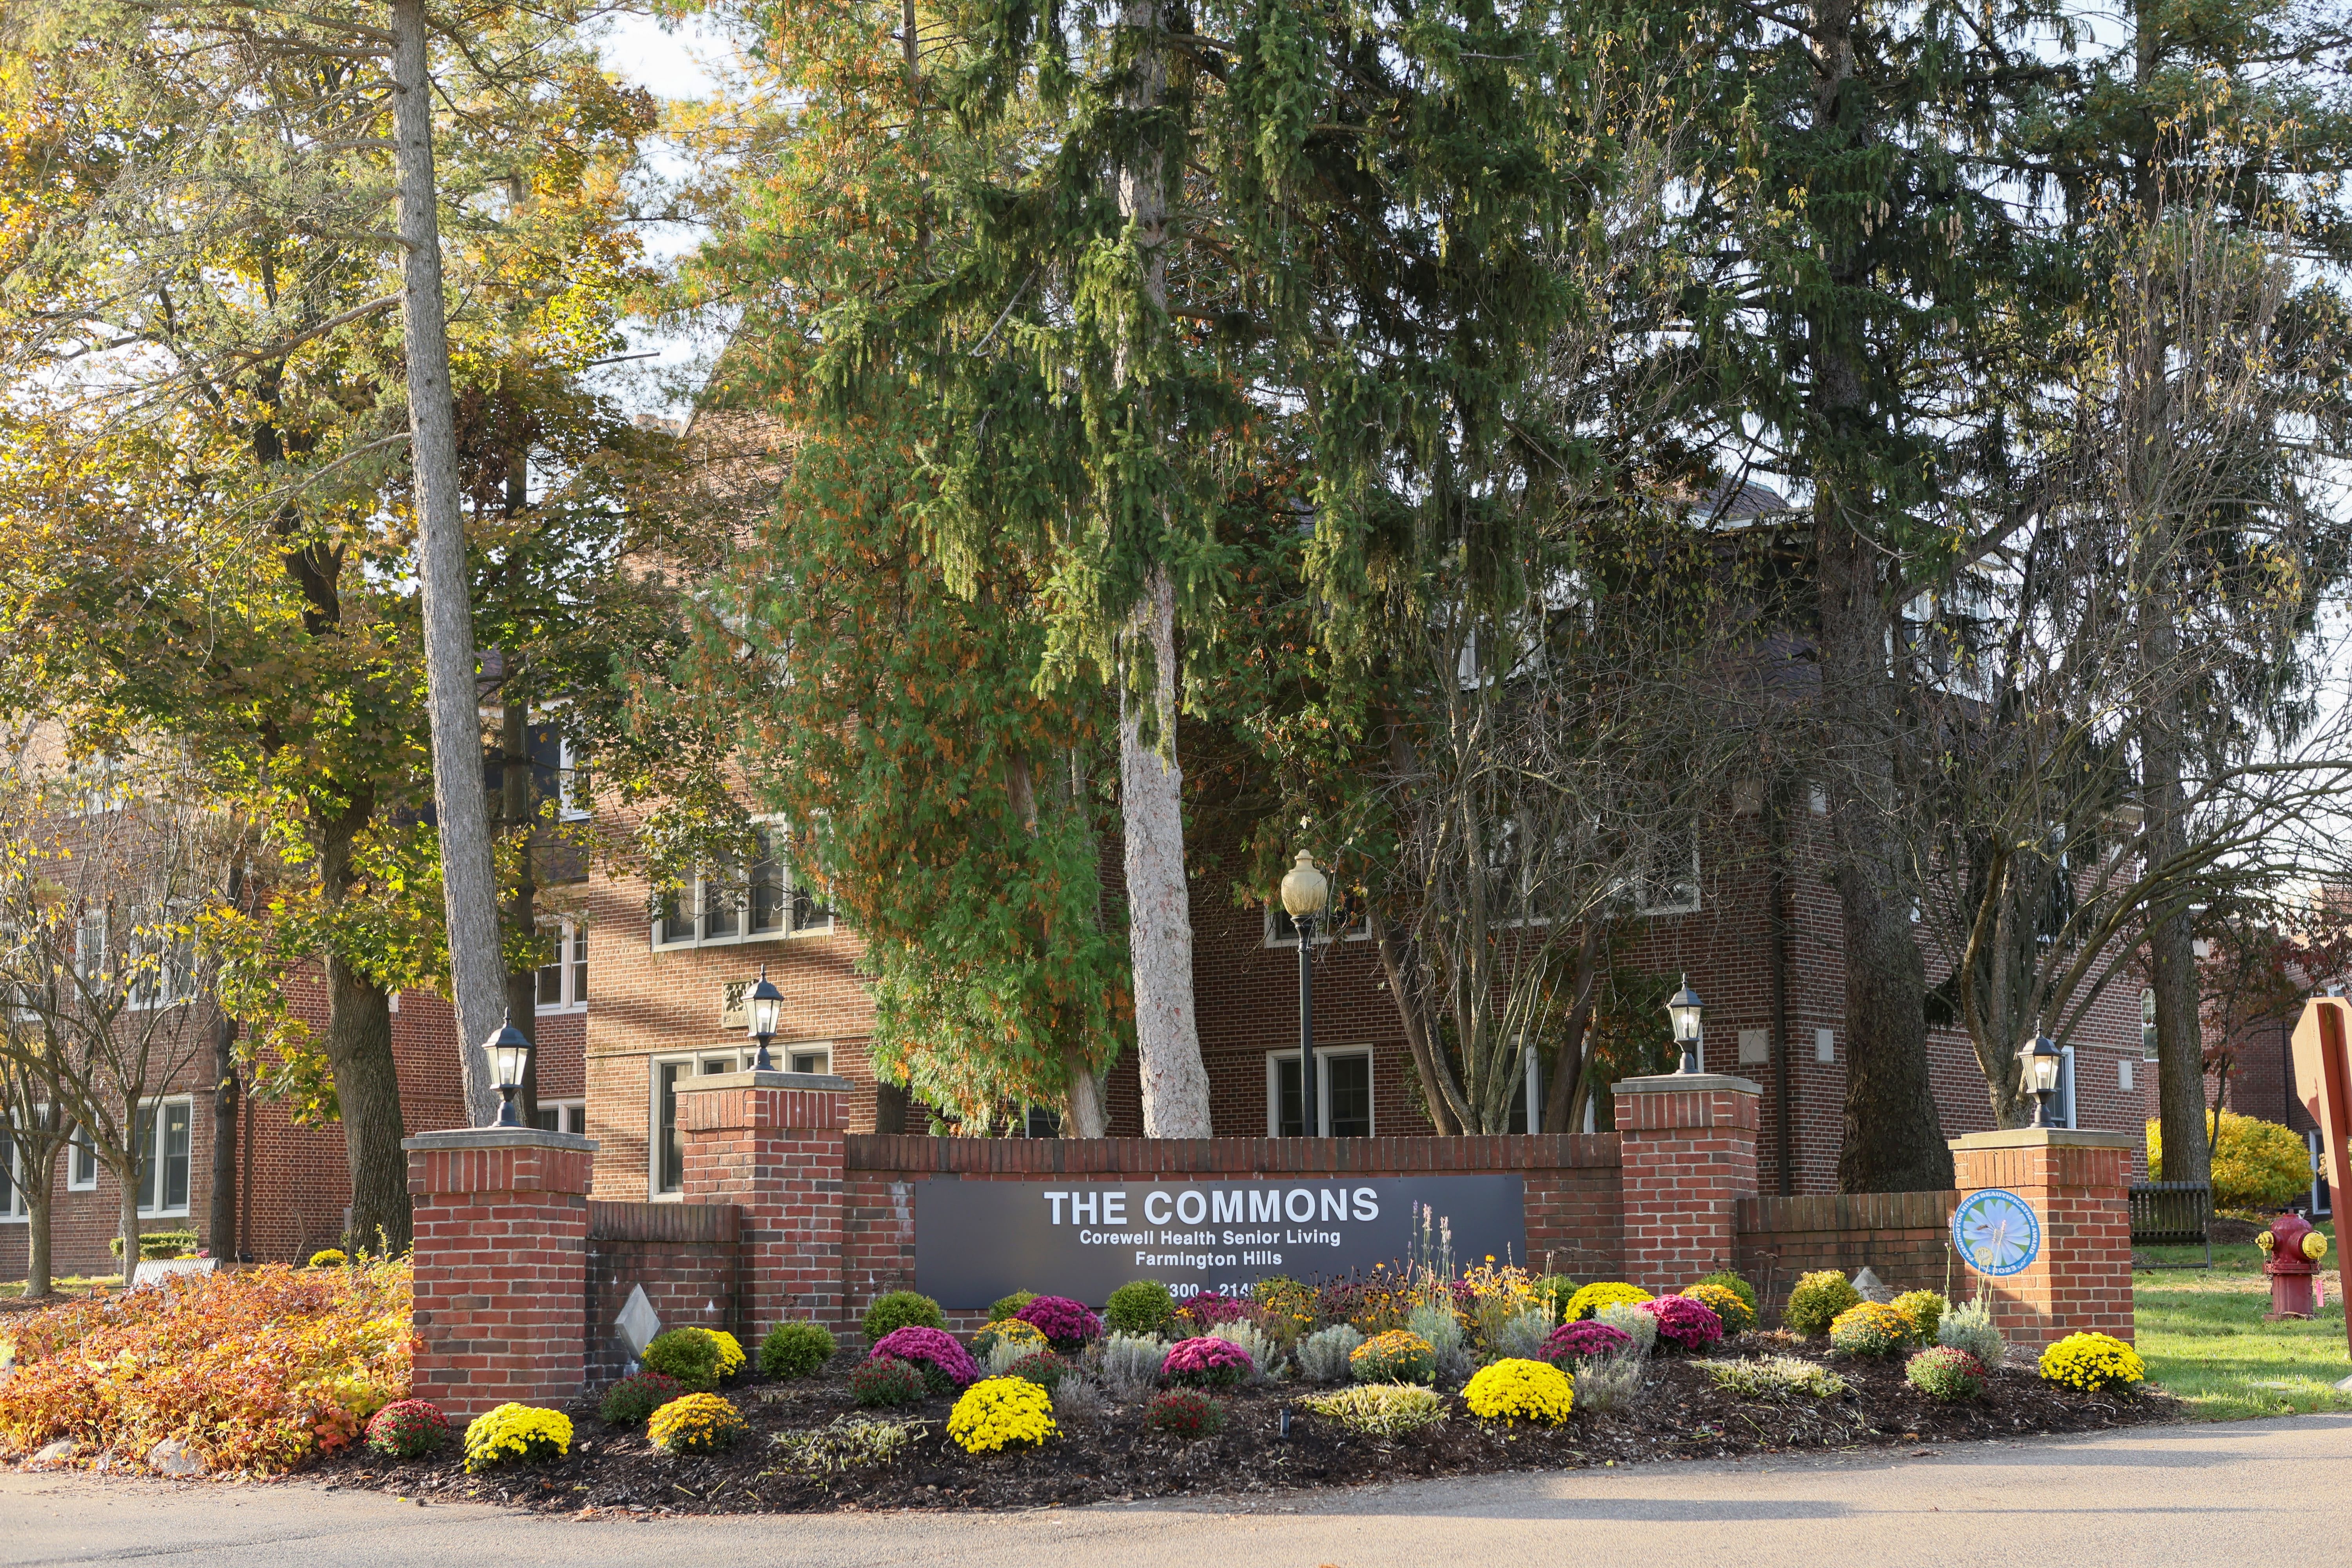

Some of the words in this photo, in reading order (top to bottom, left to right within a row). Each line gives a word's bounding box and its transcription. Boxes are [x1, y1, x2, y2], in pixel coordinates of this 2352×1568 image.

[1044, 1192, 1127, 1225] THE
[1144, 1187, 1379, 1225] COMMONS
[1961, 1195, 1980, 1212] HILLS
[1980, 1192, 2036, 1225] BEAUTIFICATION
[1080, 1229, 1153, 1244] Corewell
[1161, 1230, 1216, 1245] Health
[1223, 1230, 1280, 1245] Senior
[1287, 1229, 1340, 1247] Living
[1956, 1212, 1975, 1261] FARMINGTON
[2029, 1227, 2037, 1254] AWARD
[1136, 1251, 1236, 1269] Farmington
[1243, 1250, 1282, 1265] Hills
[1993, 1265, 2017, 1273] 2023
